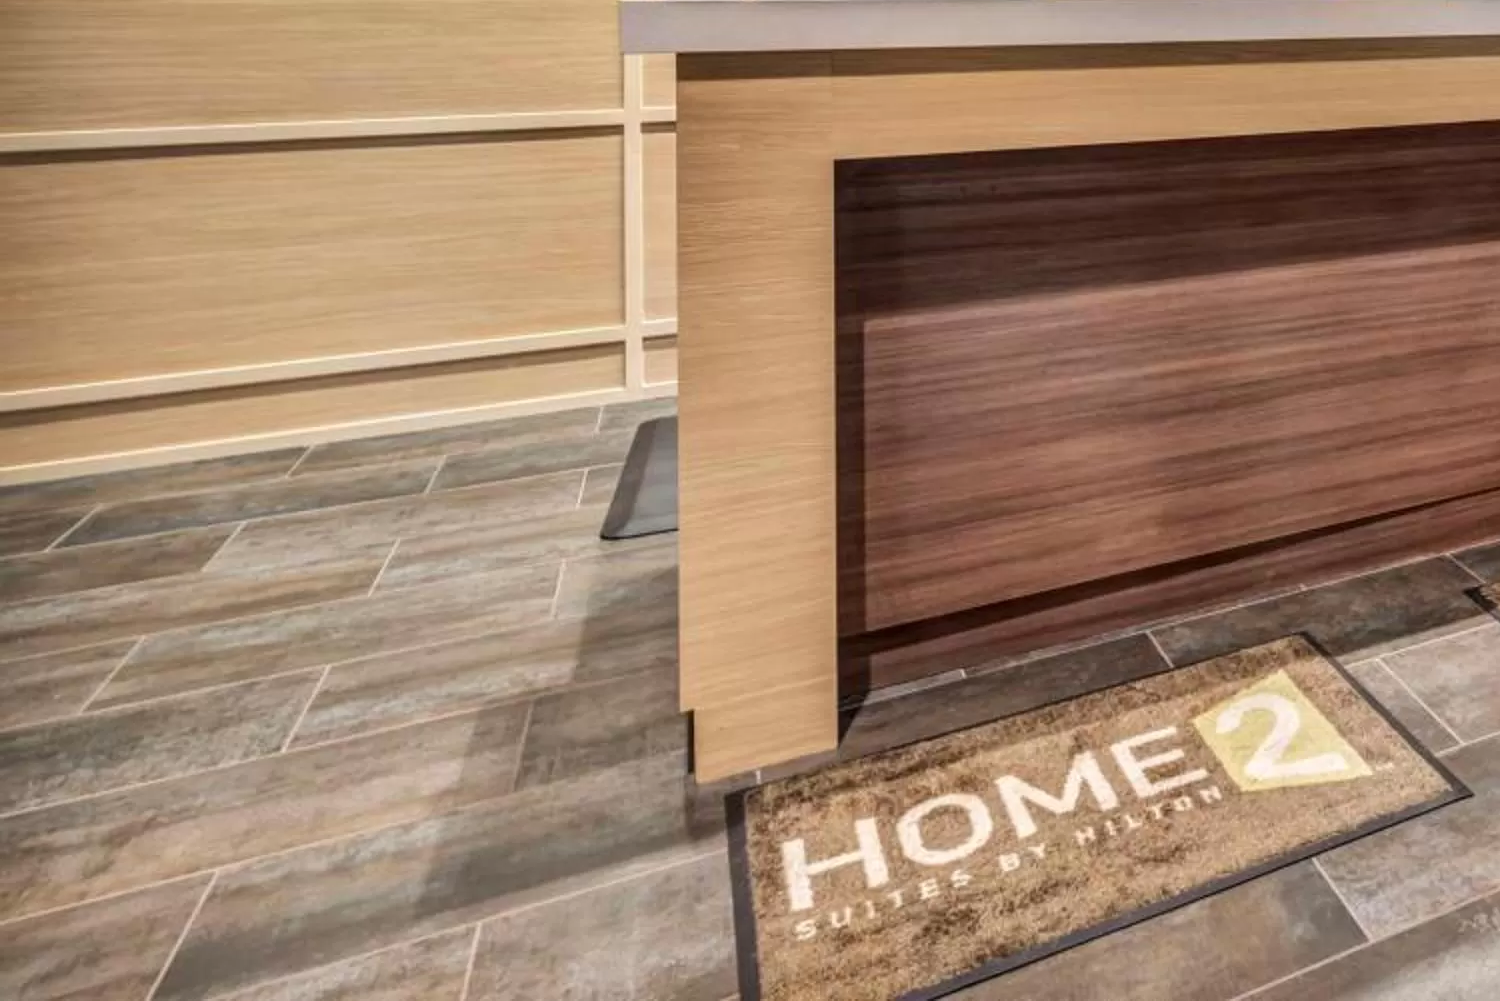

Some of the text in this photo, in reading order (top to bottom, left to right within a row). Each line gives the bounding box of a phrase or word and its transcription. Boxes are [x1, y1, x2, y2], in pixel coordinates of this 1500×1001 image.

[794, 785, 1223, 941] SUITES BY HILTON
